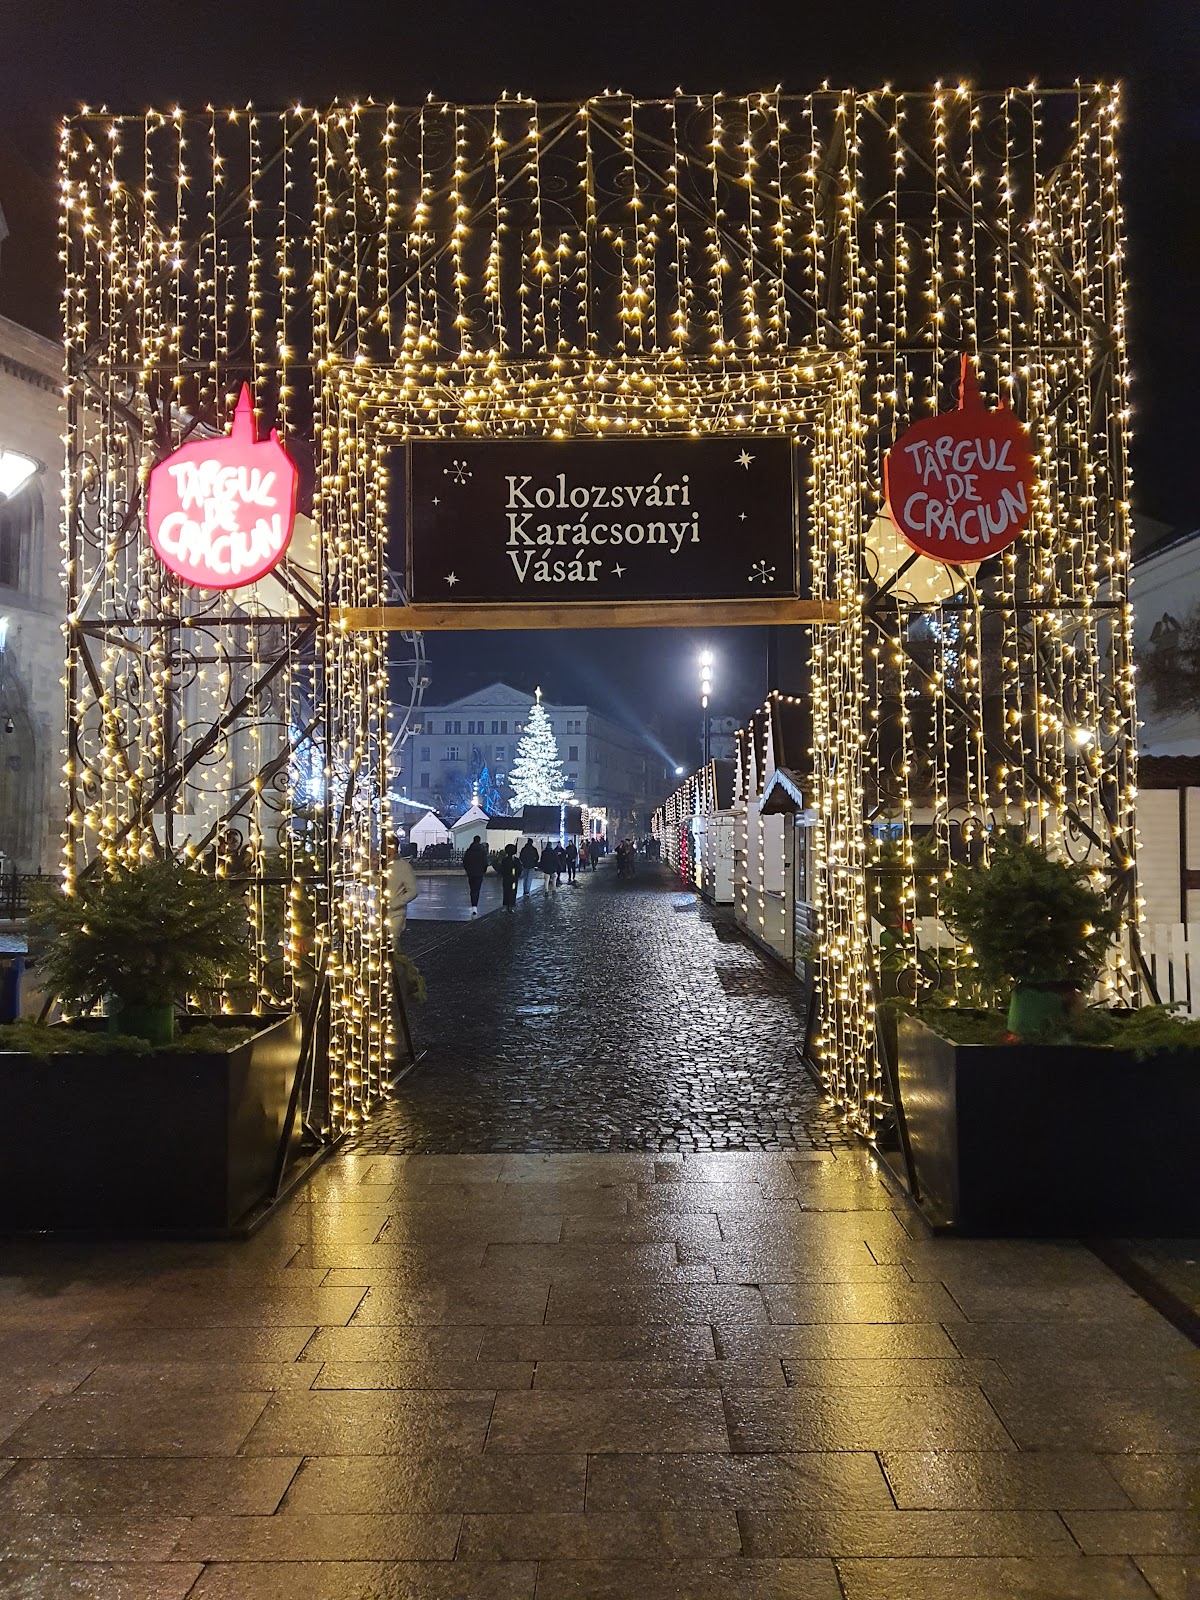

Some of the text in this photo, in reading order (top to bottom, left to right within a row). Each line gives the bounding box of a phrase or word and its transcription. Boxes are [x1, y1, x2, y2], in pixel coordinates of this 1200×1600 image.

[904, 435, 1016, 486] TÂRGUL
[505, 473, 691, 509] Kolozsvári
[945, 473, 982, 501] DE
[204, 497, 239, 532] DE
[903, 481, 1028, 545] CRĂCIUN
[505, 512, 700, 554] Karácsonyi
[506, 548, 603, 583] Vásár
